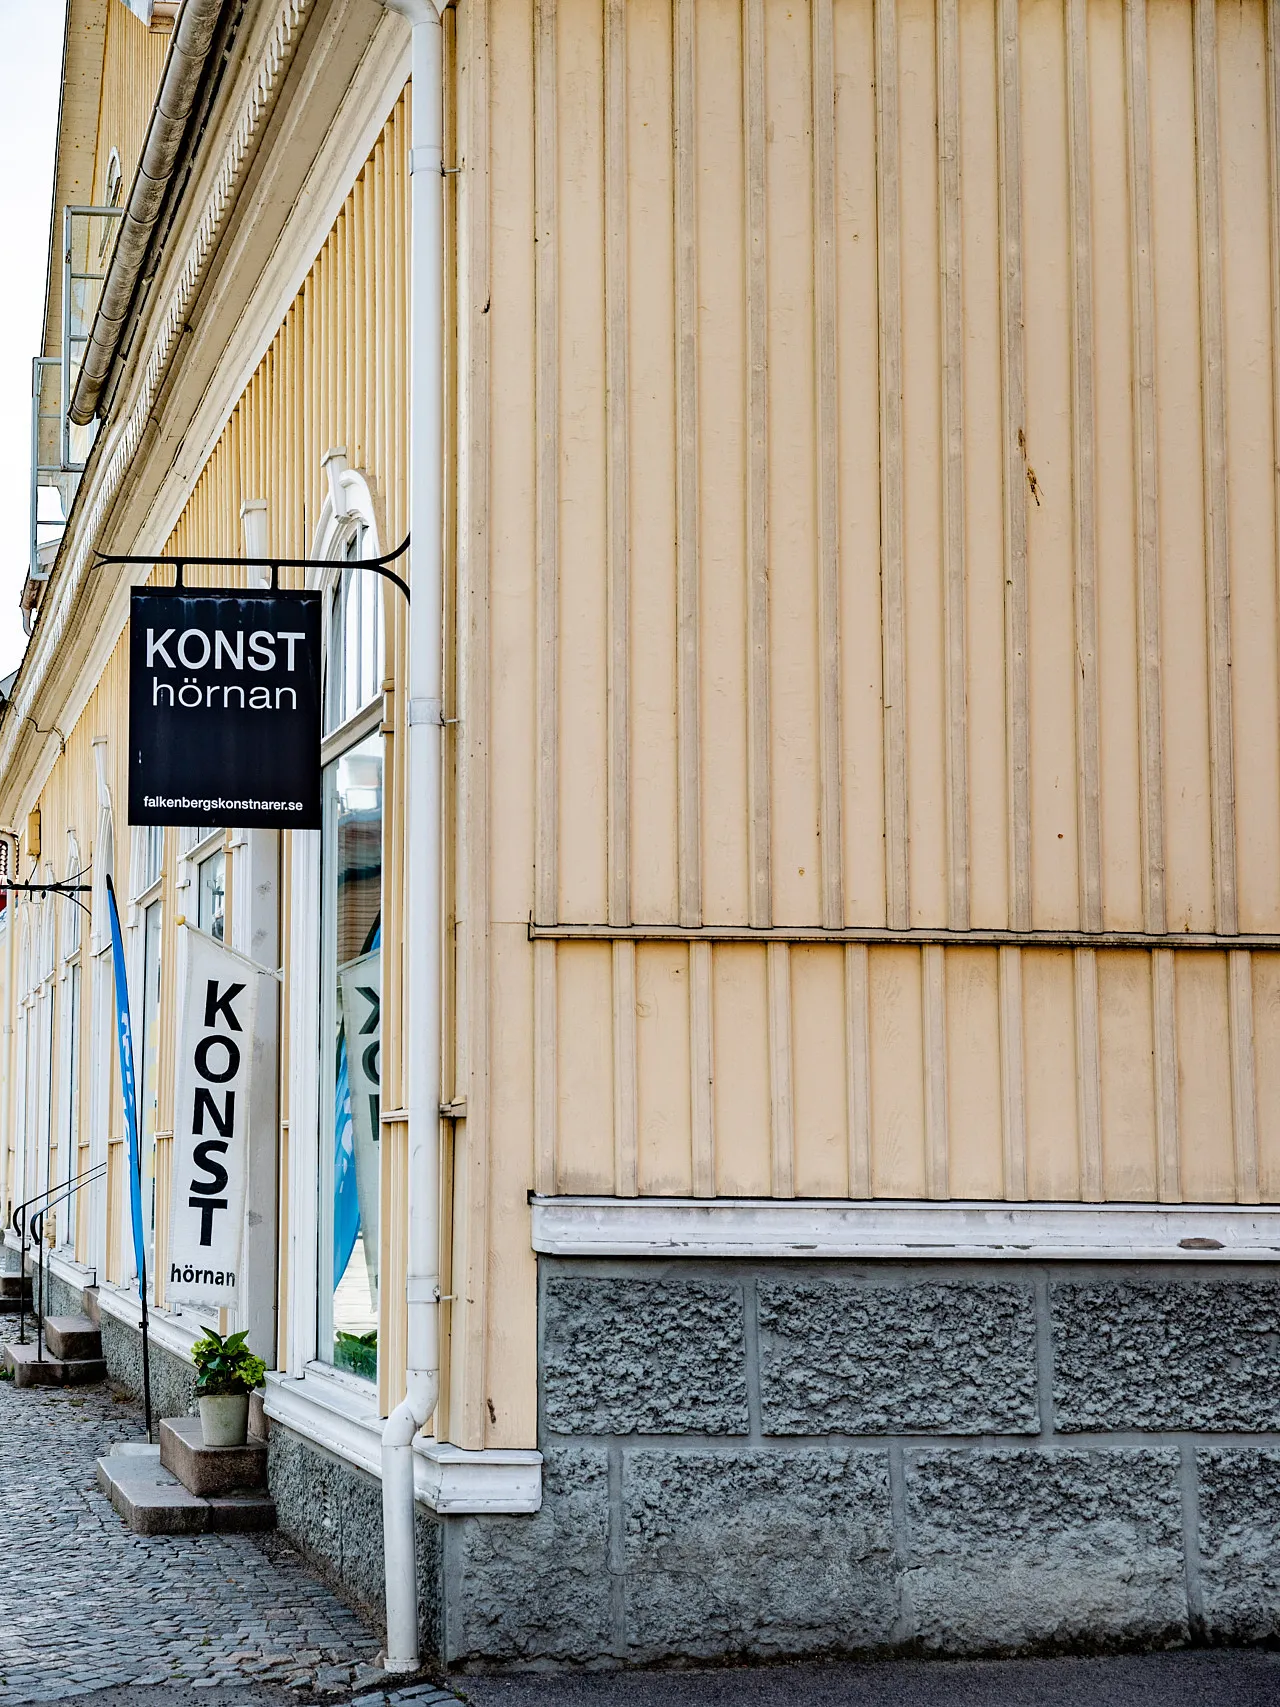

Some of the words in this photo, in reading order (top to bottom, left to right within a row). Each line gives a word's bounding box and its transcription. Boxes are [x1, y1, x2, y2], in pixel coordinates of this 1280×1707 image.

[146, 628, 306, 672] KONST
[152, 676, 297, 710] hörnan
[143, 796, 304, 811] falkenbergskonstnarer.se
[188, 979, 247, 1247] KONST
[171, 1264, 236, 1287] hörnan
